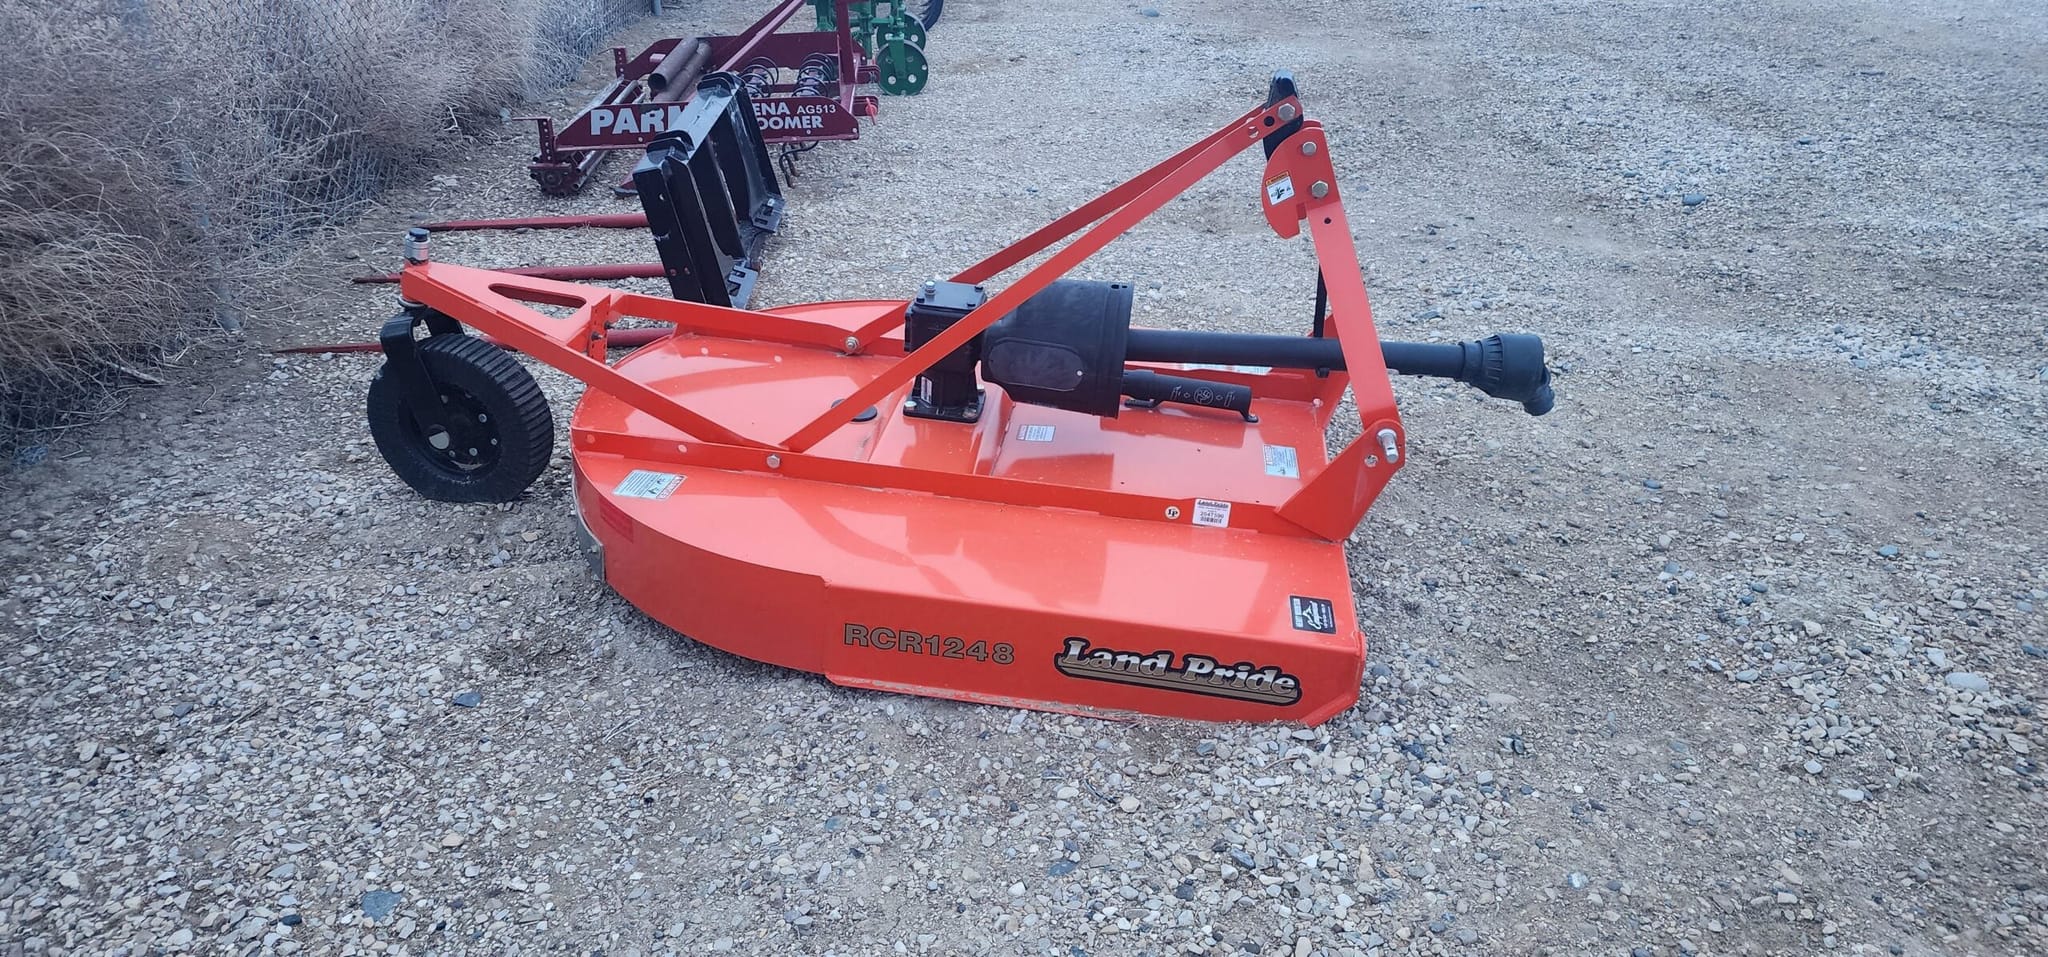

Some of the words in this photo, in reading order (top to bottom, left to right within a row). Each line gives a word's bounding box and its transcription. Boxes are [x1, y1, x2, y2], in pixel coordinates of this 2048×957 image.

[797, 105, 836, 114] AG513
[844, 623, 1015, 665] RCR1248
[1060, 638, 1174, 677] Land
[1182, 655, 1298, 696] Pride
